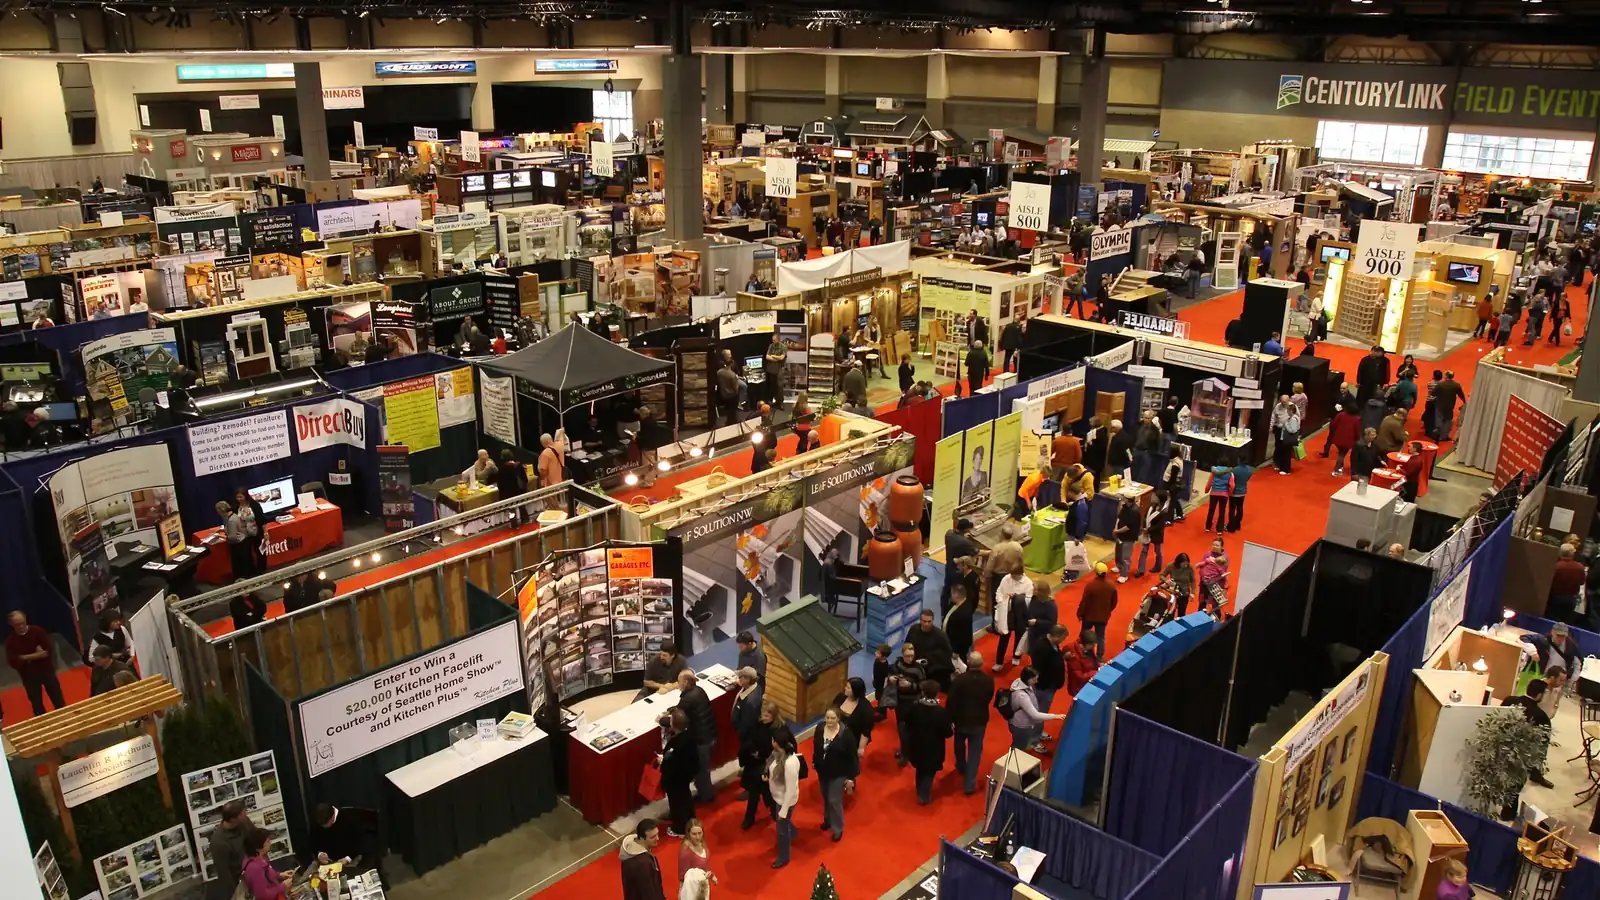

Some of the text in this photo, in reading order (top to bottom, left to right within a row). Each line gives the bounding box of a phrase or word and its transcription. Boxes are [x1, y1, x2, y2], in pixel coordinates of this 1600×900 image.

[1455, 81, 1514, 115] FIELD
[596, 166, 610, 175] 600
[770, 177, 792, 185] AISLE
[772, 184, 791, 195] 700
[1016, 205, 1043, 216] AISLE
[263, 222, 292, 230] satisfaction
[323, 216, 354, 226] architects
[1017, 215, 1041, 229] 800
[1092, 231, 1130, 250] OLYMPIC
[1364, 247, 1406, 261] AISLE
[1365, 258, 1402, 276] 900
[434, 296, 481, 309] ABOUT GROUT
[192, 413, 284, 437] Building? Remodel? Furniture?
[234, 430, 250, 438] HOUSE
[257, 426, 267, 434] find
[297, 406, 364, 442] DirectBuy
[199, 456, 209, 464] BUY
[244, 445, 266, 454] DirectBuy
[267, 442, 285, 450] member
[221, 442, 236, 450] things
[237, 440, 251, 448] really
[209, 452, 279, 471] DirectBuySeattle.com
[827, 469, 861, 488] SOLUTION
[861, 461, 875, 473] NW
[693, 513, 734, 540] SOLUTION
[733, 506, 753, 523] NW
[374, 652, 456, 690] Enter to Win a
[345, 653, 484, 717] $20,000 Kitchen Facelift
[473, 685, 500, 699] Kitchen
[502, 678, 519, 688] Plus
[326, 711, 379, 737] Courtesy
[381, 702, 393, 715] of
[395, 687, 432, 710] Seattle
[434, 676, 465, 693] Home
[369, 717, 391, 733] and
[393, 699, 435, 725] Kitchen
[61, 762, 101, 779] Lauchlin
[87, 760, 132, 779] Associates
